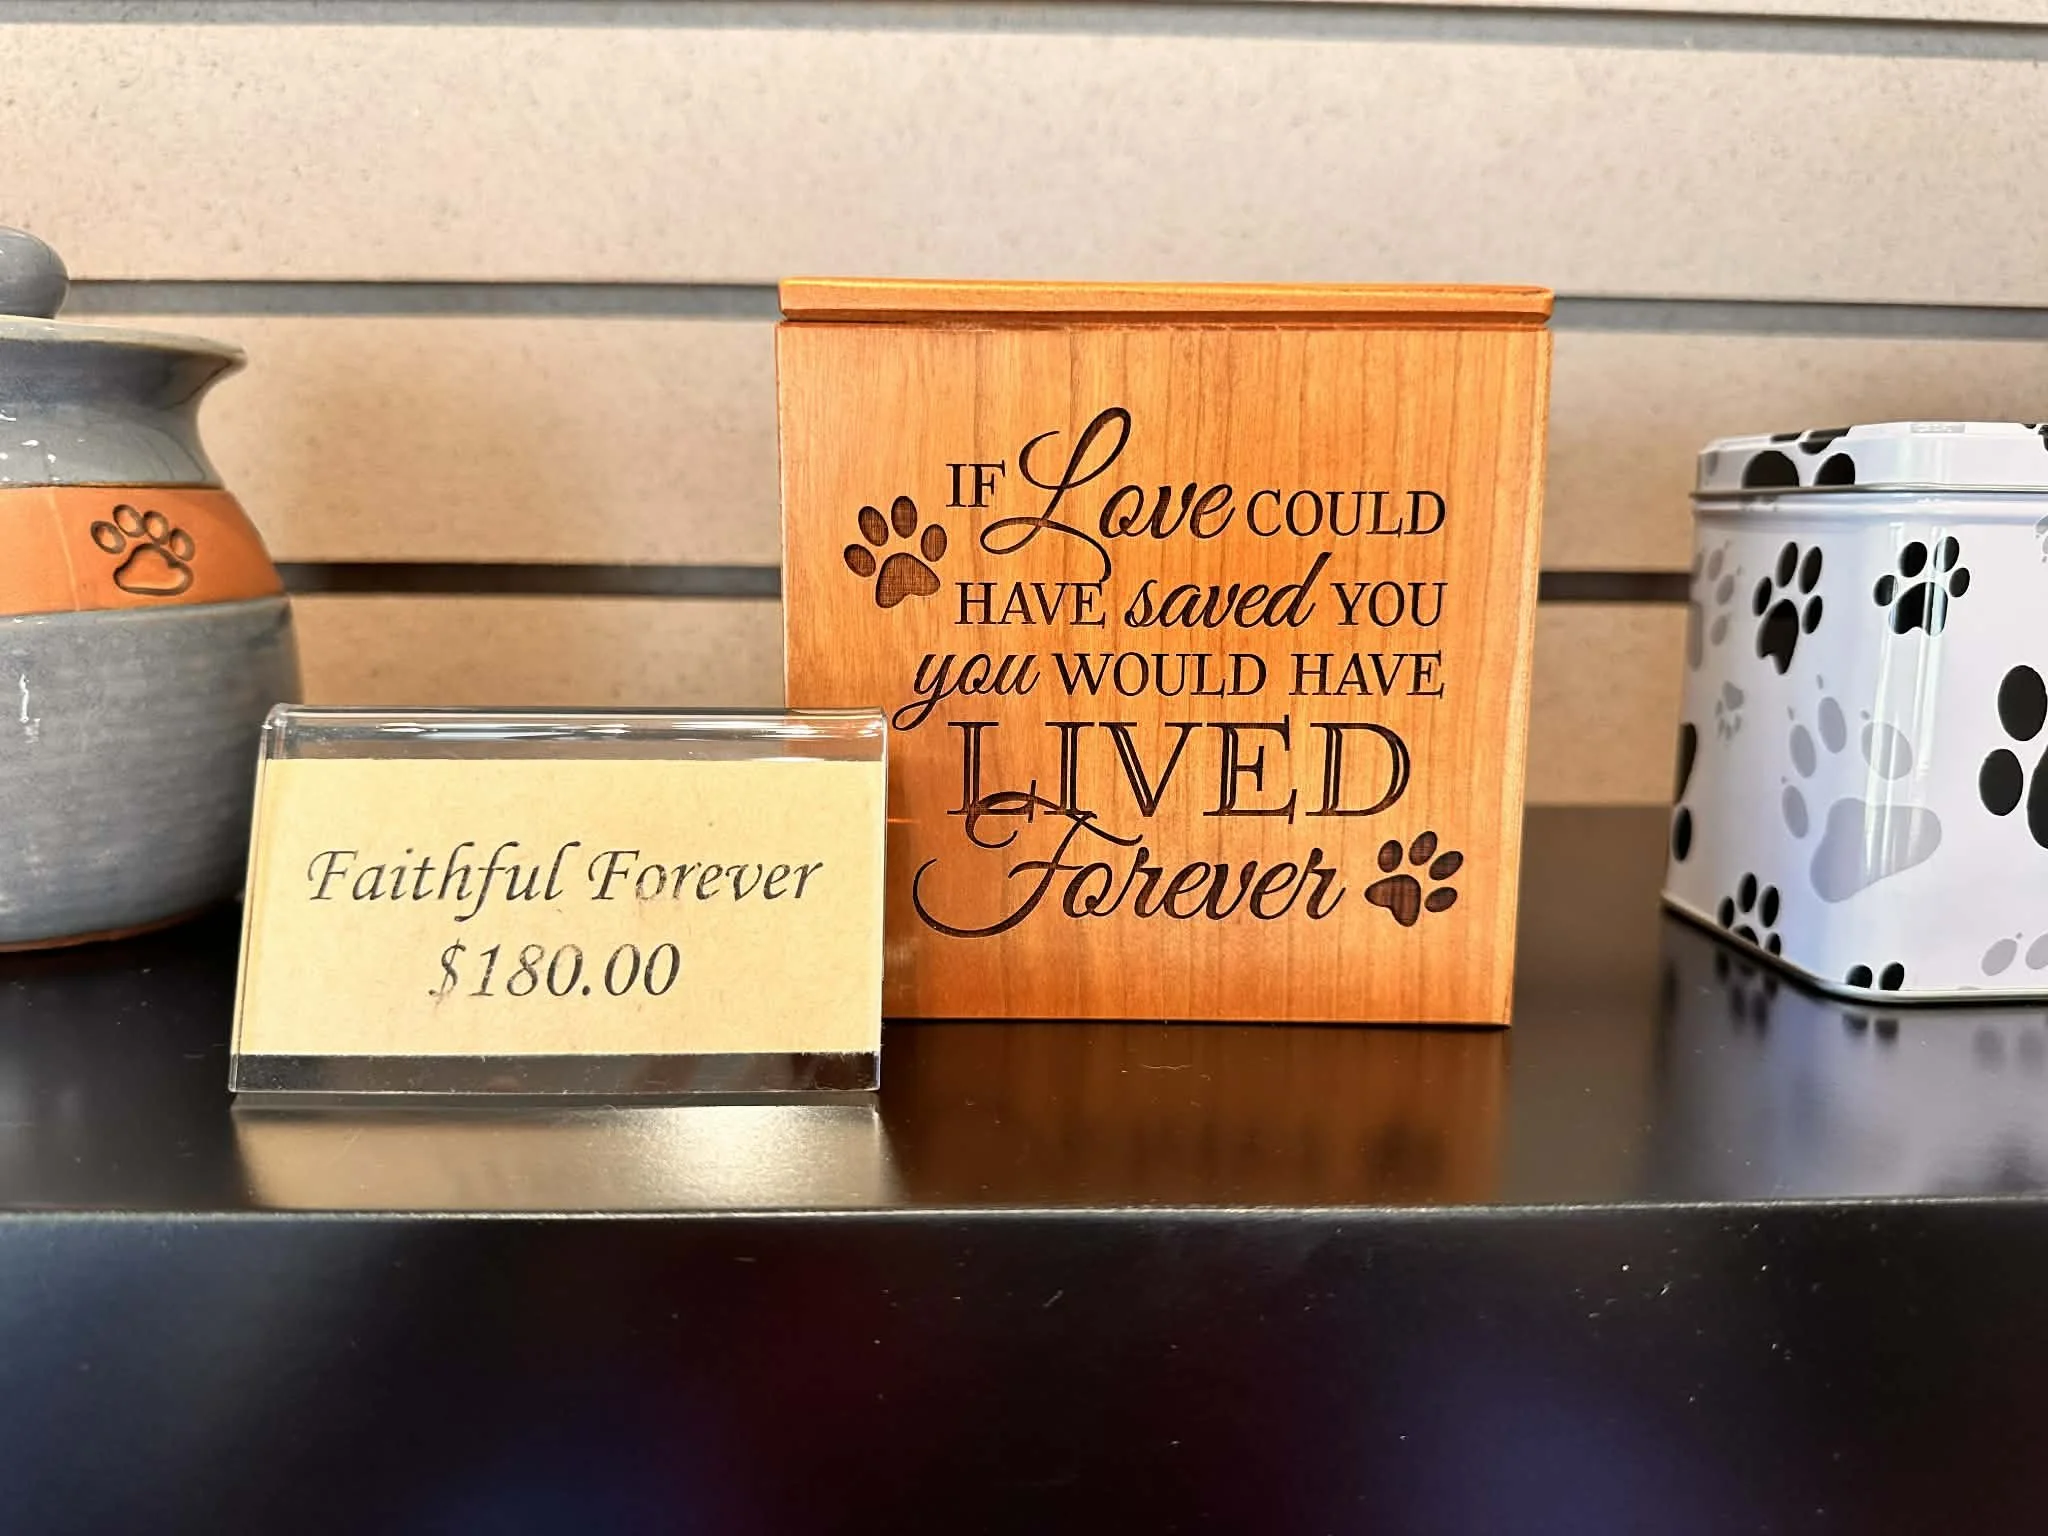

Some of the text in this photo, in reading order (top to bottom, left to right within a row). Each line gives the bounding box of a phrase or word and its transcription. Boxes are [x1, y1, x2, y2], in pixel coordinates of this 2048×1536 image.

[946, 407, 1446, 583] IF Love COULD
[954, 552, 1448, 628] HAVE saved YOU
[892, 650, 1445, 731] you WOULD HAVE
[947, 714, 1411, 824] LIVED
[307, 840, 824, 922] Faithful Forever
[912, 791, 1346, 939] Forever
[428, 938, 682, 1000] $180.00
